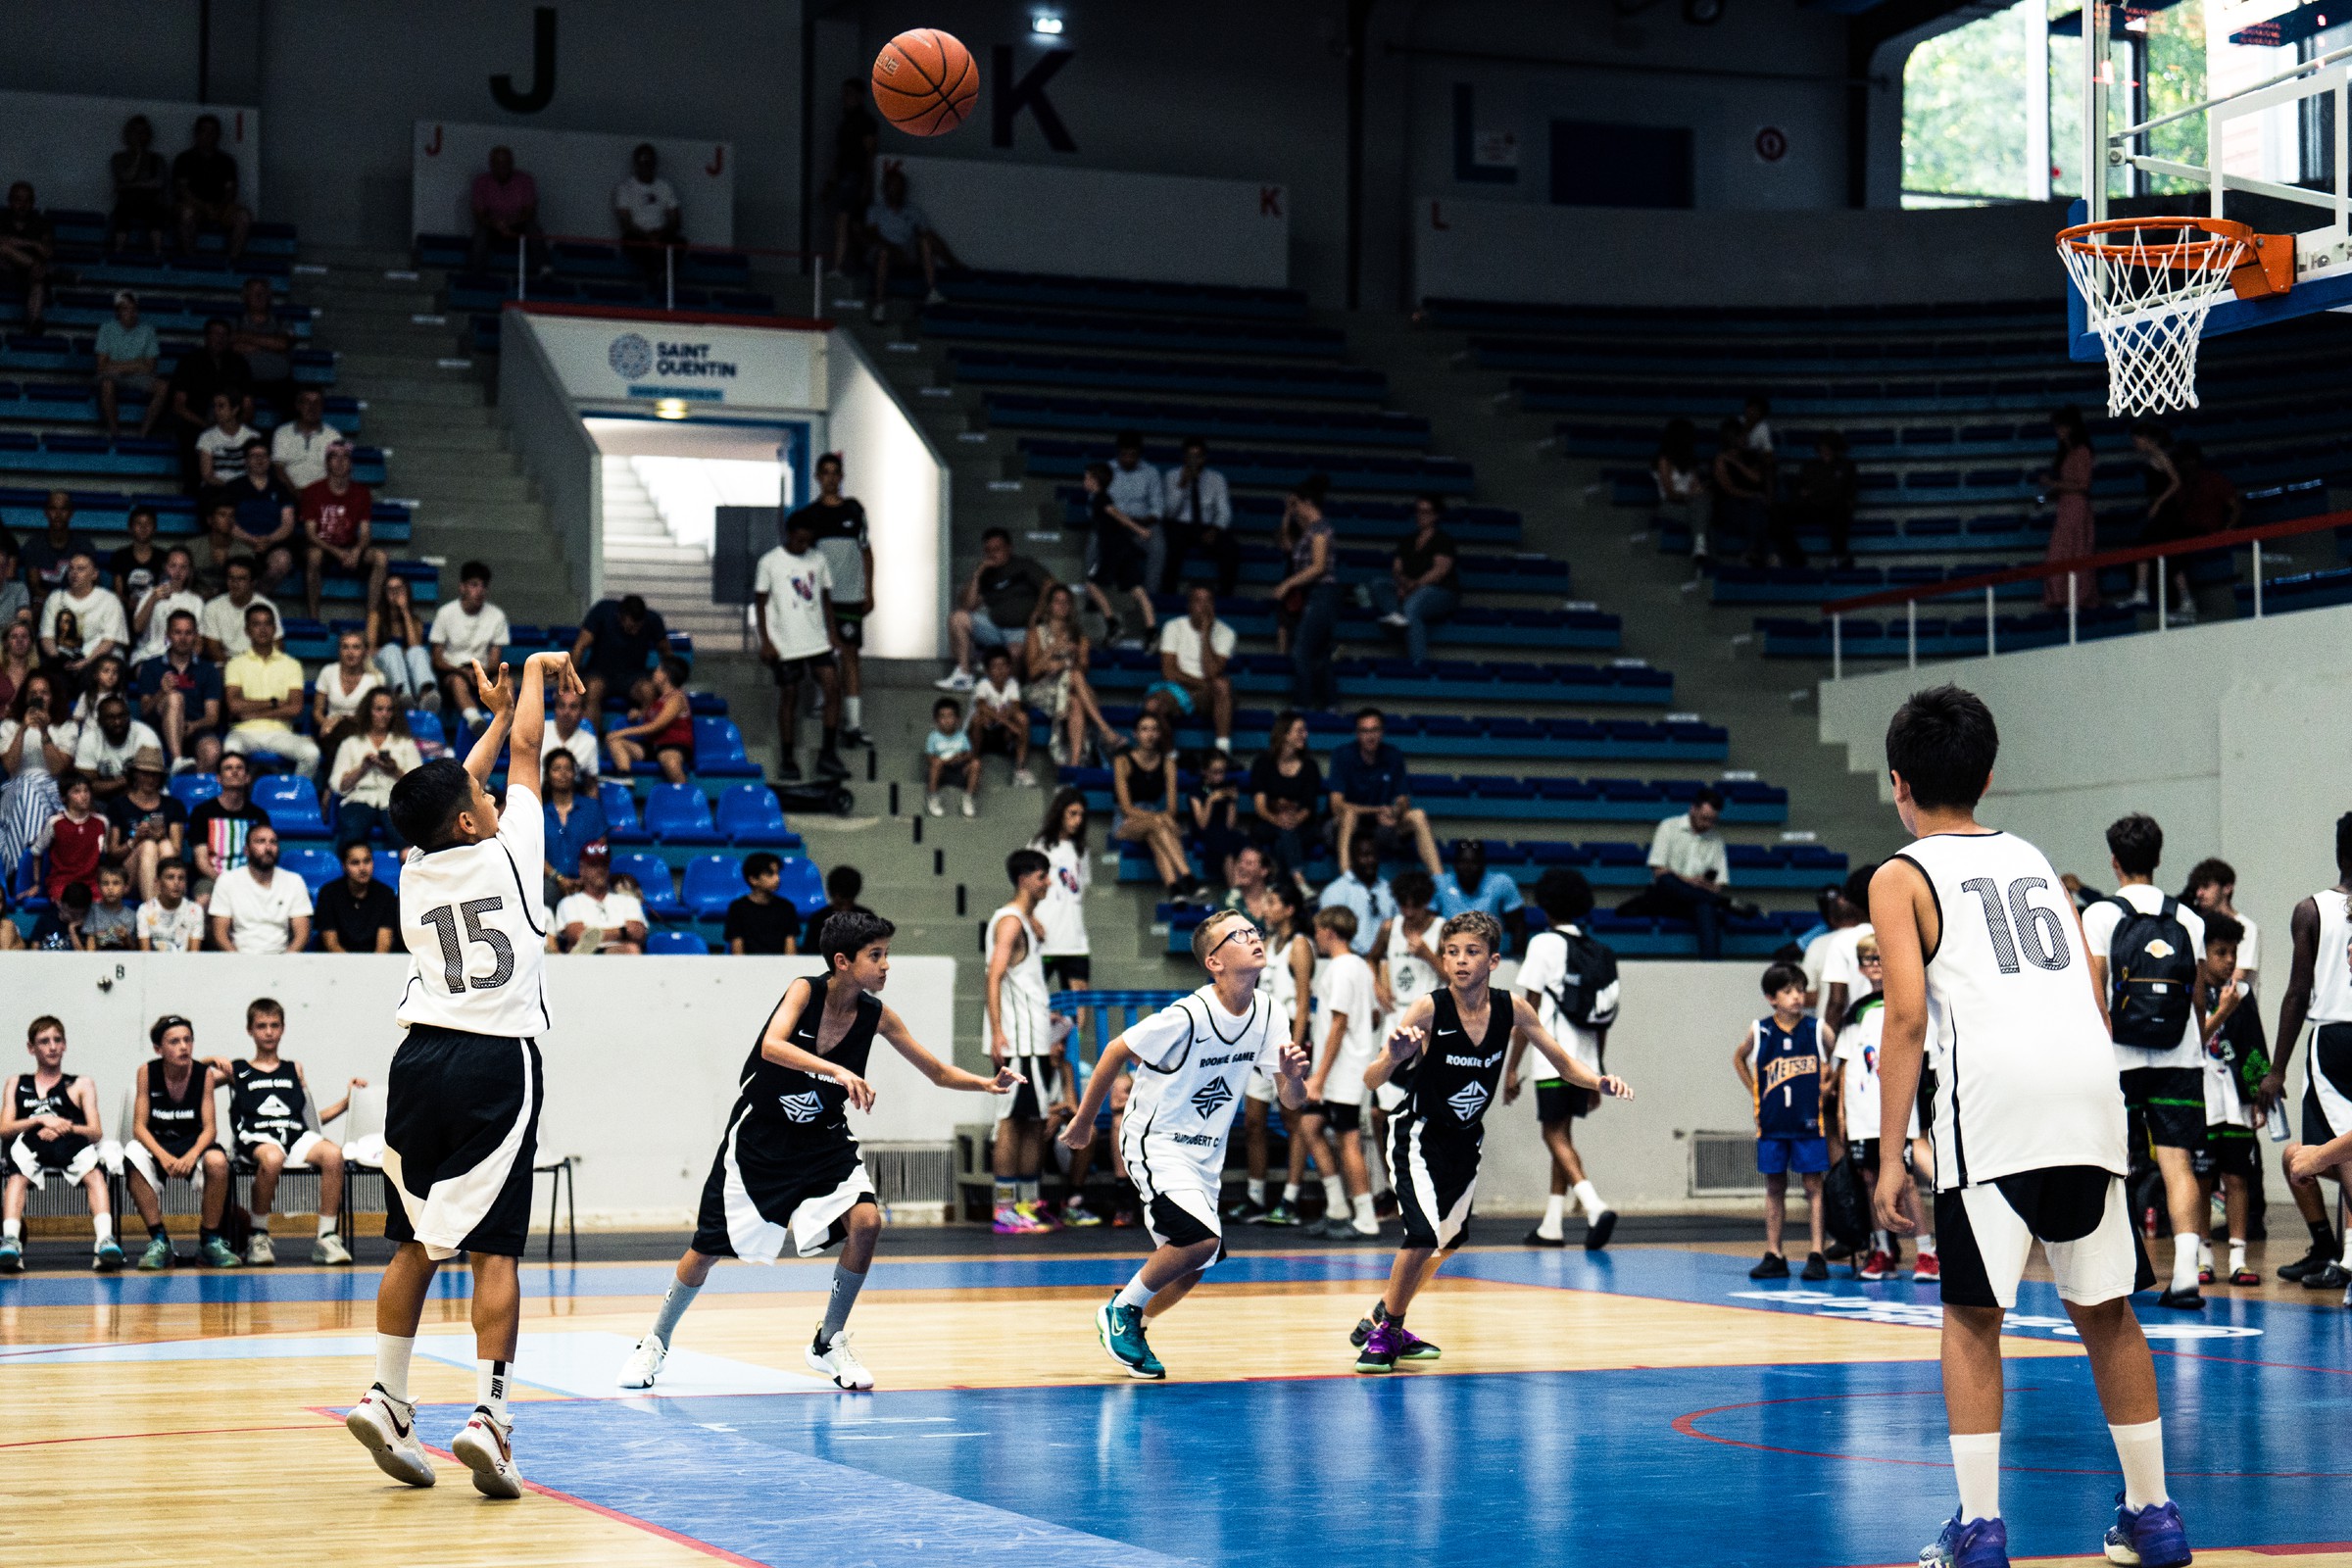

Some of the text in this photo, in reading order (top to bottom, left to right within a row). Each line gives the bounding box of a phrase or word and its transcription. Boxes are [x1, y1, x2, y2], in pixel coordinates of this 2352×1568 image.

[491, 9, 556, 113] J
[992, 45, 1077, 152] K
[425, 126, 442, 157] J
[1454, 83, 1517, 182] L
[706, 146, 723, 176] J
[1260, 187, 1282, 216] K
[1431, 201, 1448, 230] L
[657, 342, 710, 358] SAINT
[656, 359, 737, 377] QUENTIN
[1961, 876, 2071, 974] 16
[421, 896, 514, 994] 15
[1446, 1054, 1483, 1068] ROOKIE
[1784, 1085, 1792, 1108] 1
[491, 1377, 504, 1399] NIKE
